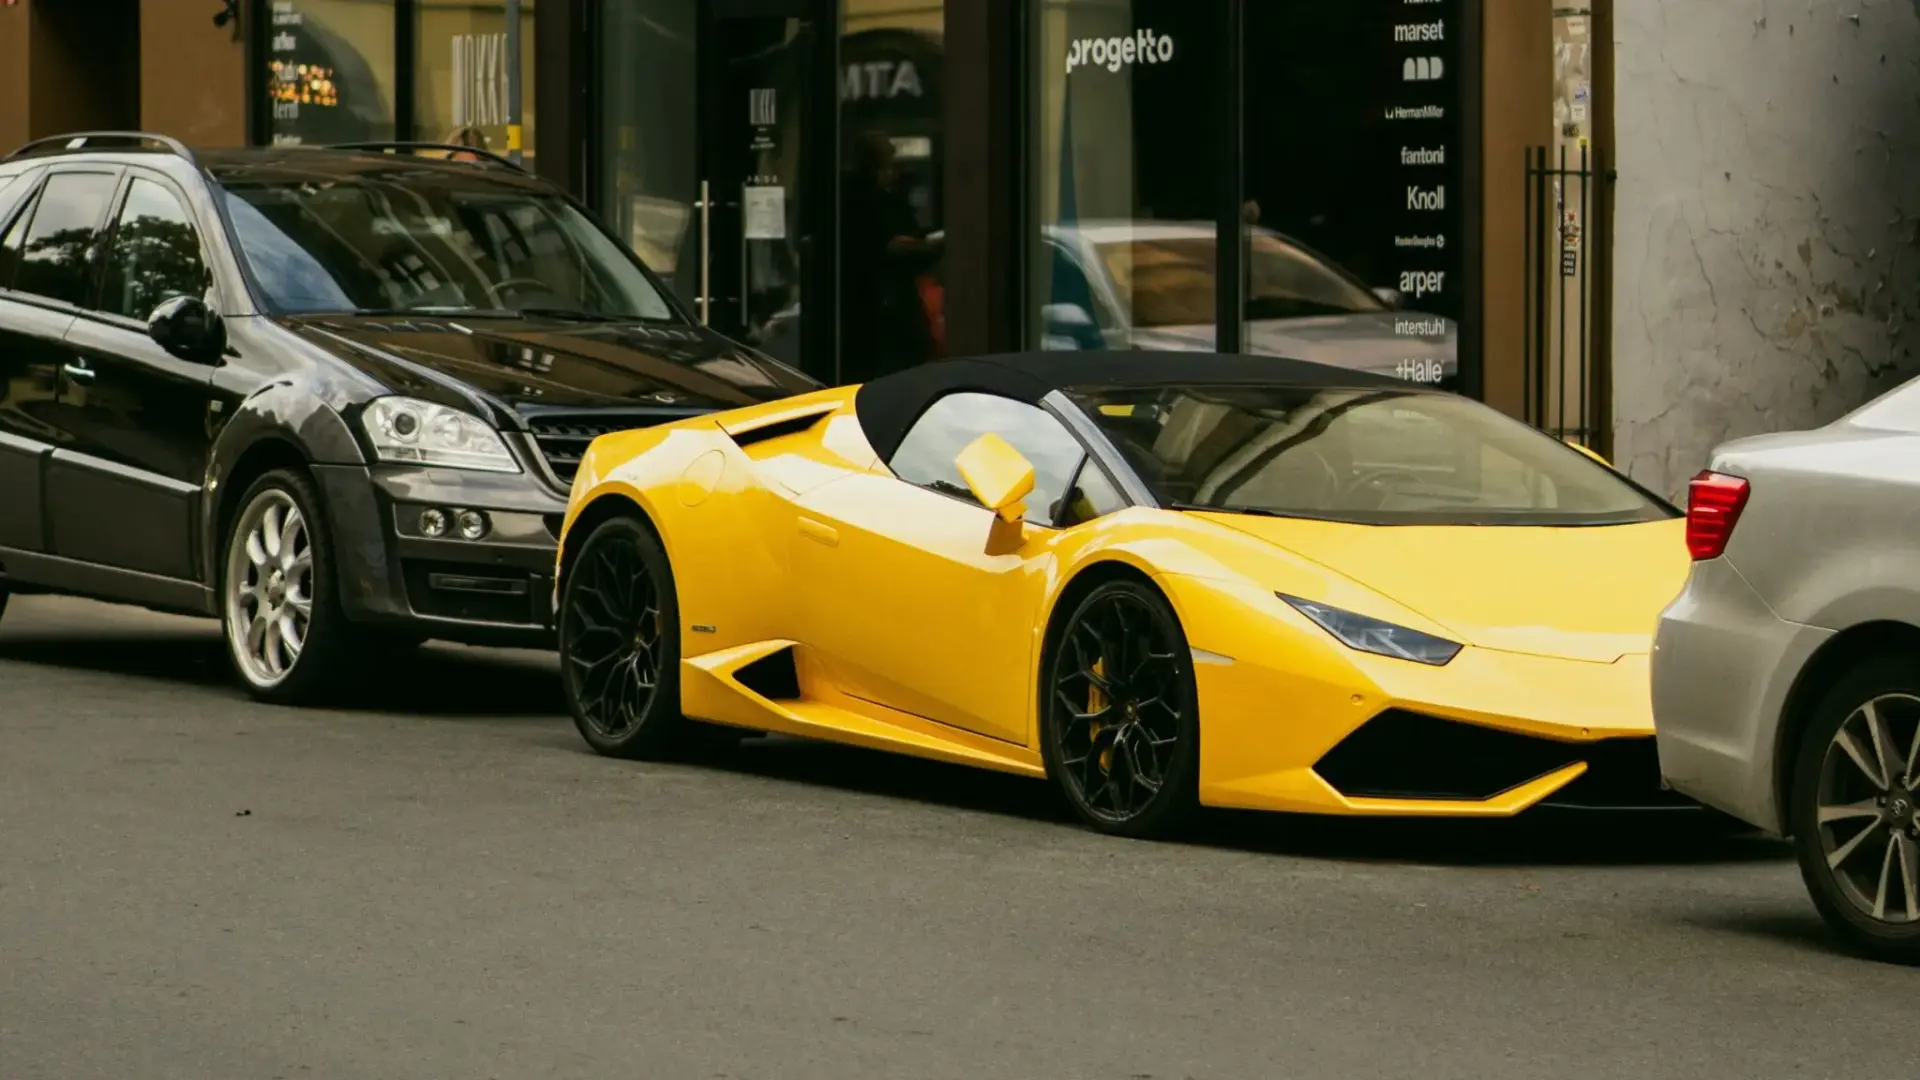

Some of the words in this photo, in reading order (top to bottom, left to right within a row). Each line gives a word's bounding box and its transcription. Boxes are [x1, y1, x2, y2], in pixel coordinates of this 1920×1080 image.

[1395, 19, 1444, 41] marset
[1066, 28, 1173, 74] progetto
[1401, 145, 1444, 164] fantoni
[1407, 185, 1444, 210] Knoll
[1400, 271, 1444, 298] arper
[1395, 318, 1445, 335] interstuhl
